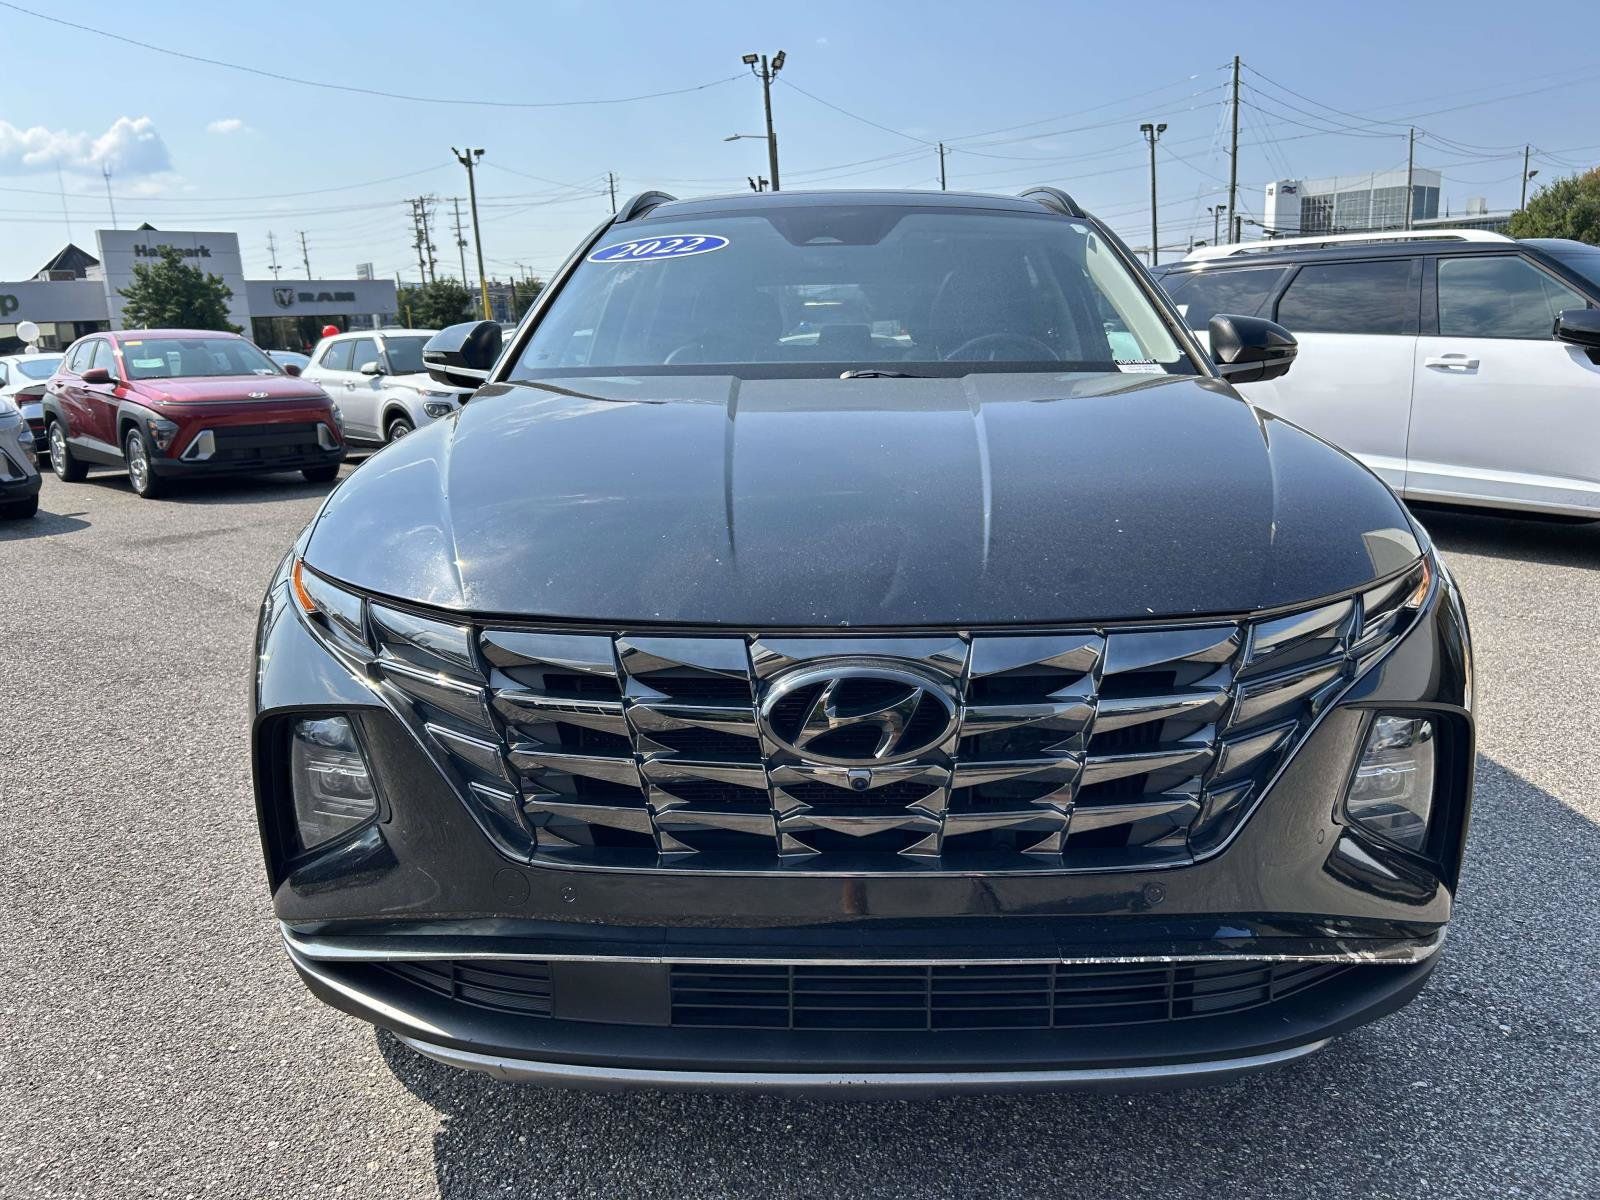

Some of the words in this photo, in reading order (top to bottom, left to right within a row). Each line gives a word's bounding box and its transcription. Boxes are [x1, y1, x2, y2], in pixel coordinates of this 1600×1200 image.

[134, 244, 212, 258] Hamark
[605, 237, 706, 260] 2022
[298, 292, 356, 302] RAM
